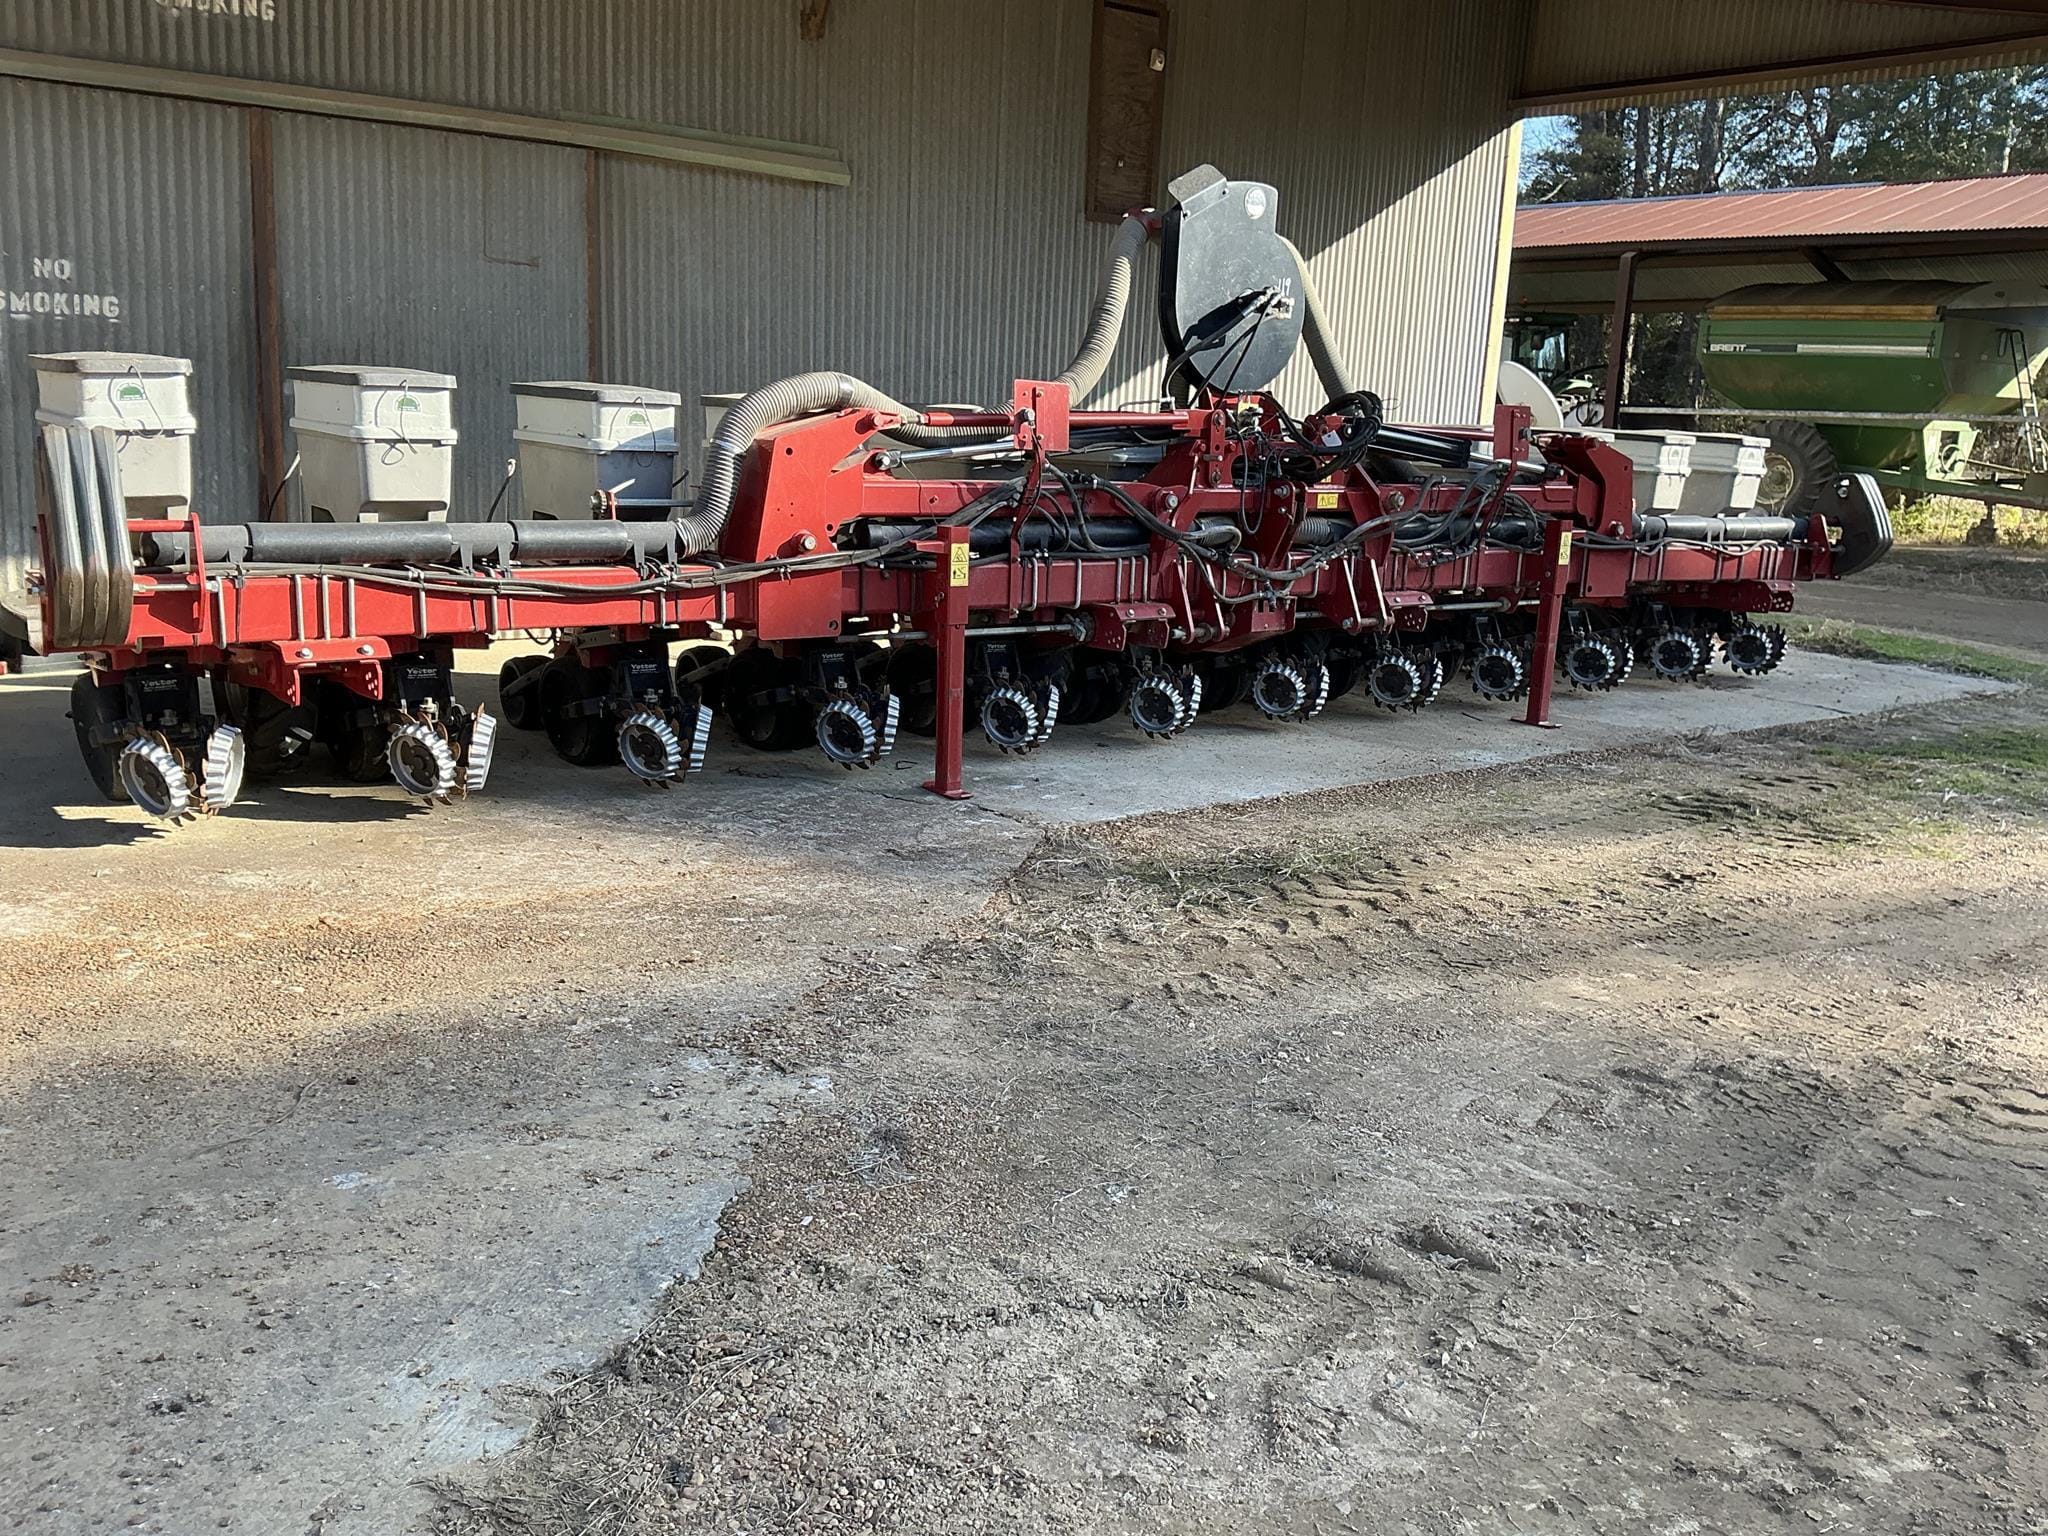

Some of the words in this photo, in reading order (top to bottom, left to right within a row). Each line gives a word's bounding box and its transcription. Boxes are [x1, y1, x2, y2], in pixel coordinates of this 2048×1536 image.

[33, 257, 71, 280] NO
[1710, 343, 1747, 352] BRENT
[140, 679, 177, 687] Yetter
